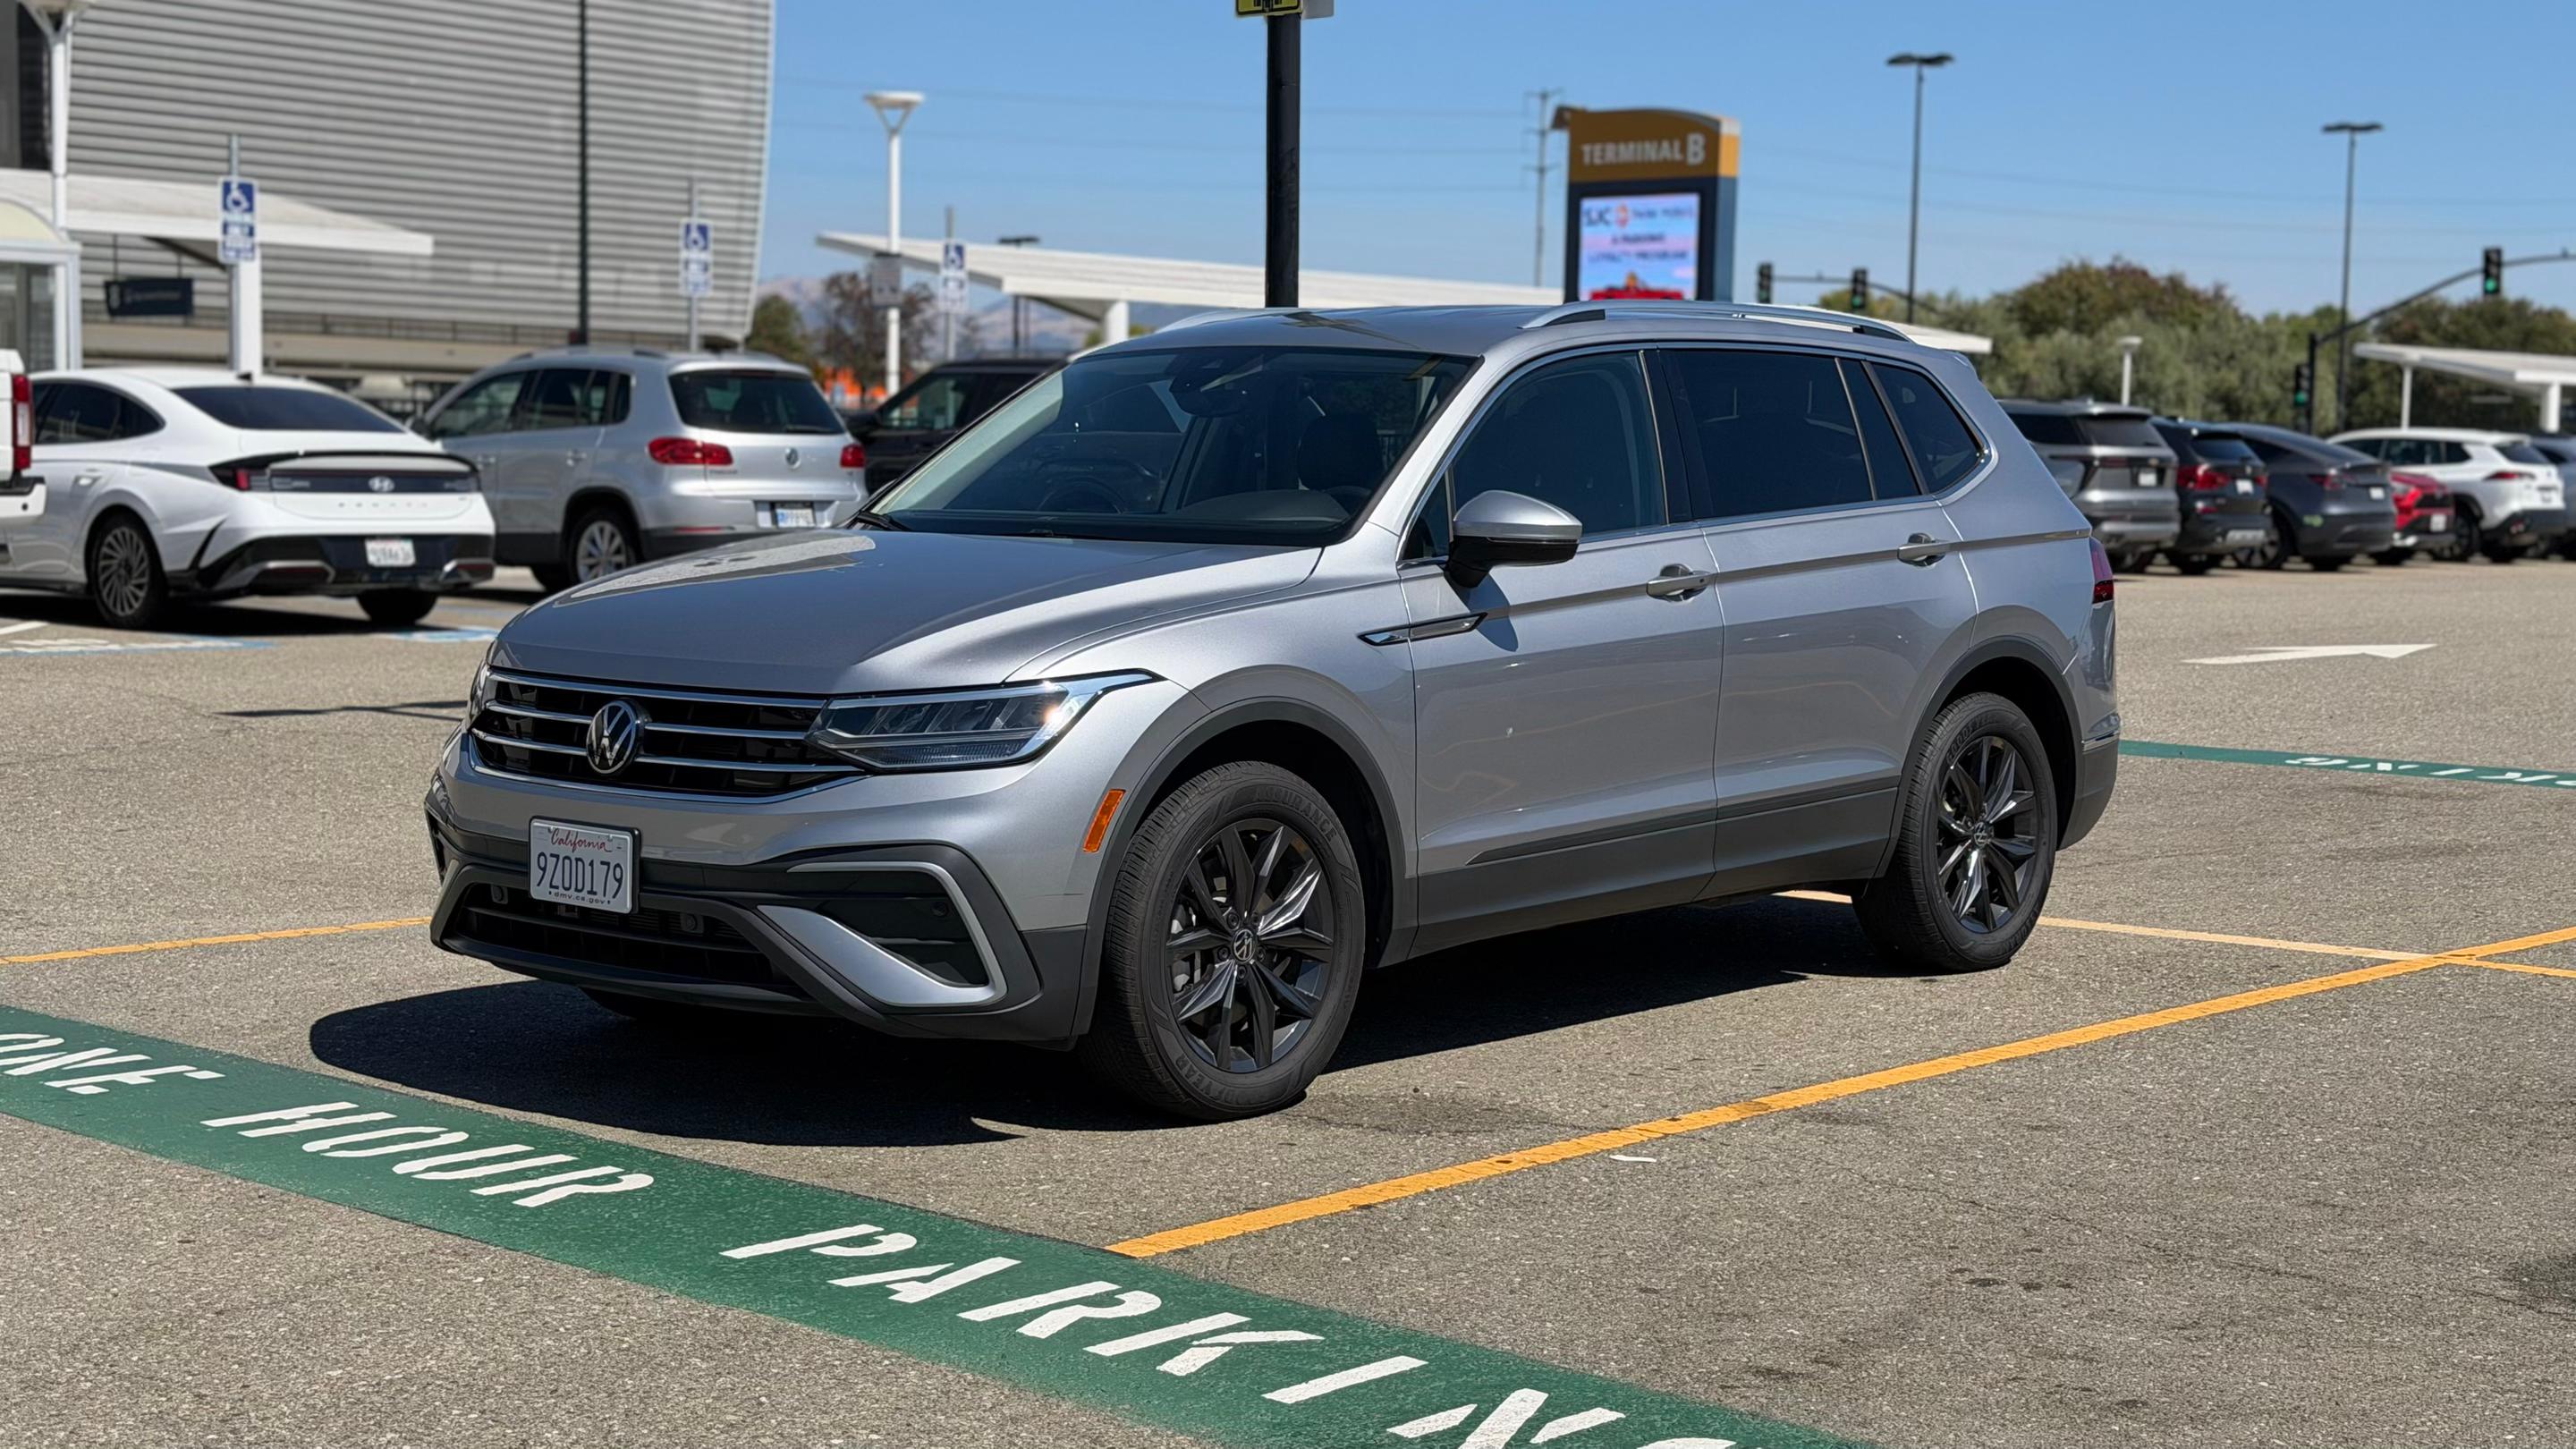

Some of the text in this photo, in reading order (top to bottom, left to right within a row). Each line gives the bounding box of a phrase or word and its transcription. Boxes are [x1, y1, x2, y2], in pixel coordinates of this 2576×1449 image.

[1581, 132, 1706, 166] TERMINAL B
[548, 827, 613, 853] California
[555, 891, 606, 904] dmv.ca.gov
[199, 1101, 654, 1208] HOUR
[720, 1224, 1737, 1449] PARKIN
